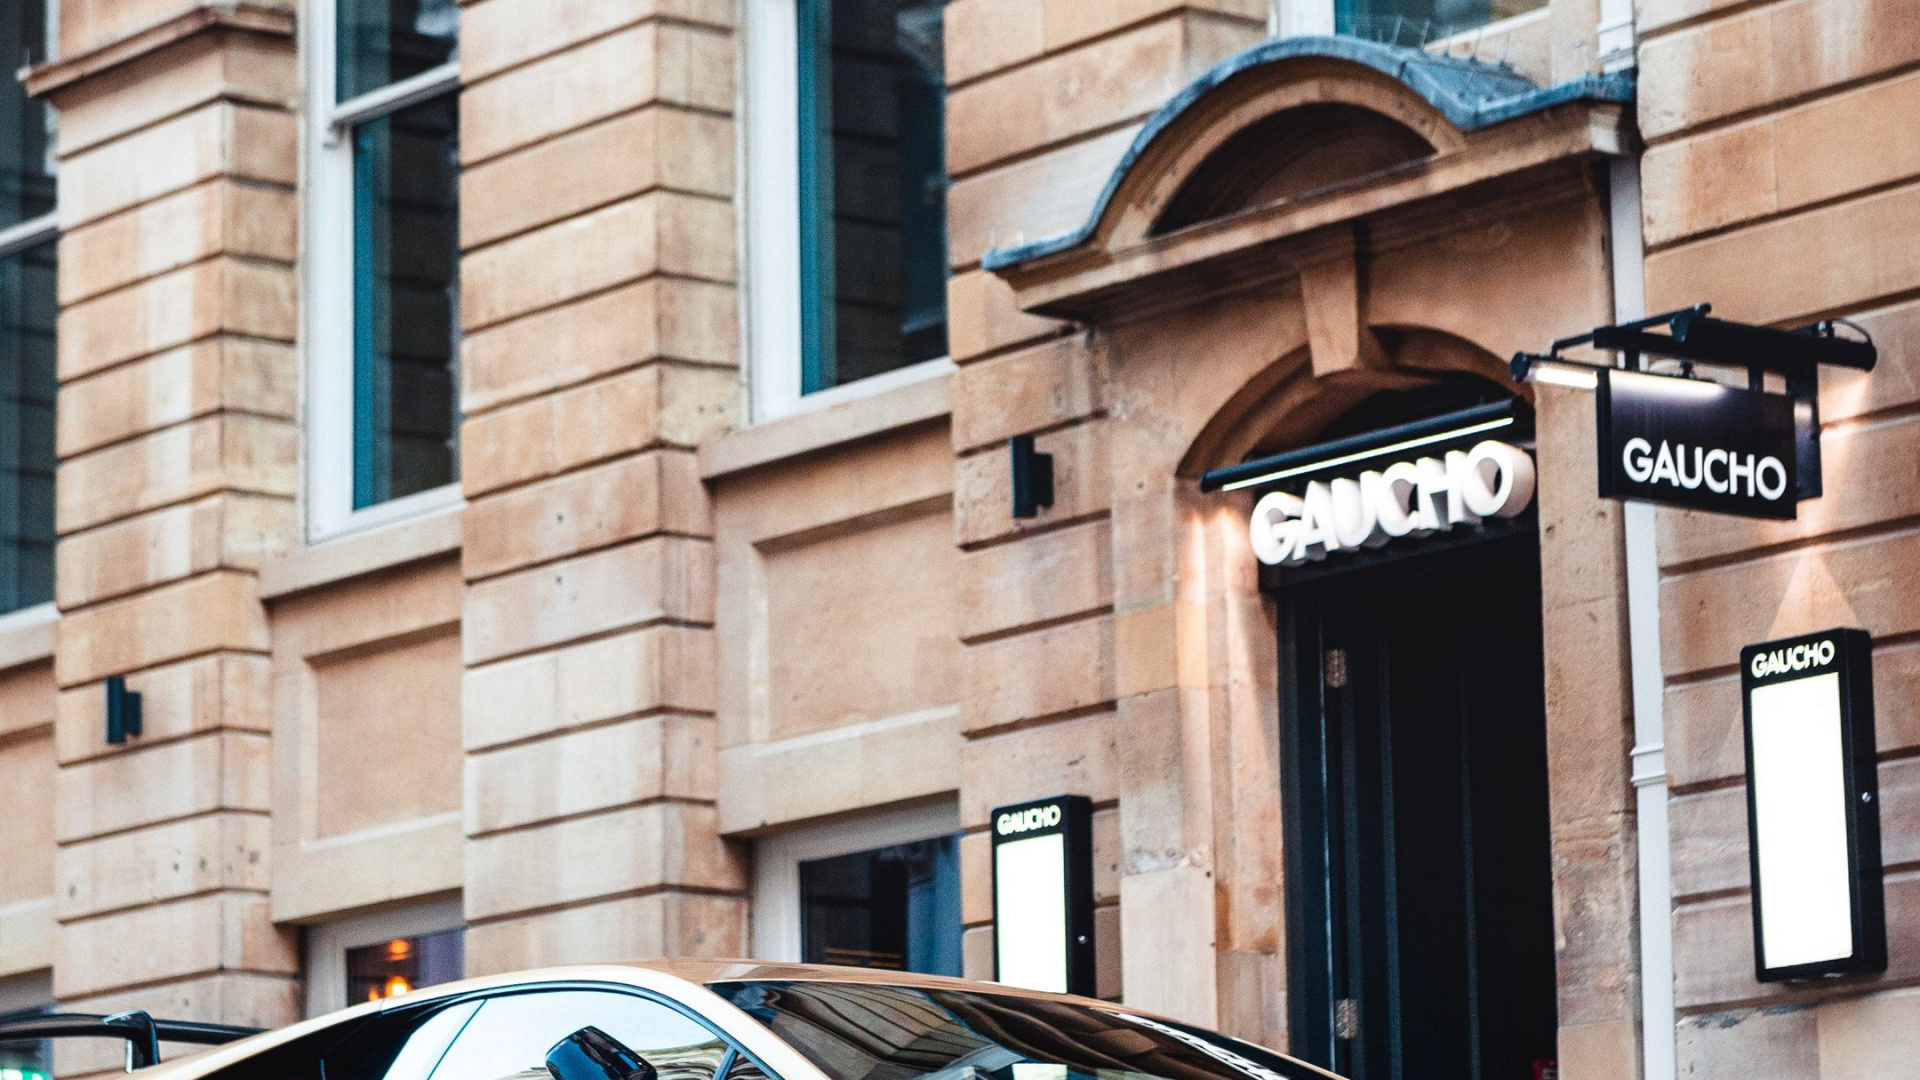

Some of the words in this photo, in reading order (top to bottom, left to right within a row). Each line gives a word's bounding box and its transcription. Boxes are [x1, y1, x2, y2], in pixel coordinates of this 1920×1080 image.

[1622, 437, 1787, 500] GAUCHO
[1250, 440, 1517, 566] GAUCHO
[1751, 639, 1835, 678] GAUCHO
[996, 804, 1062, 835] GAUCHO
